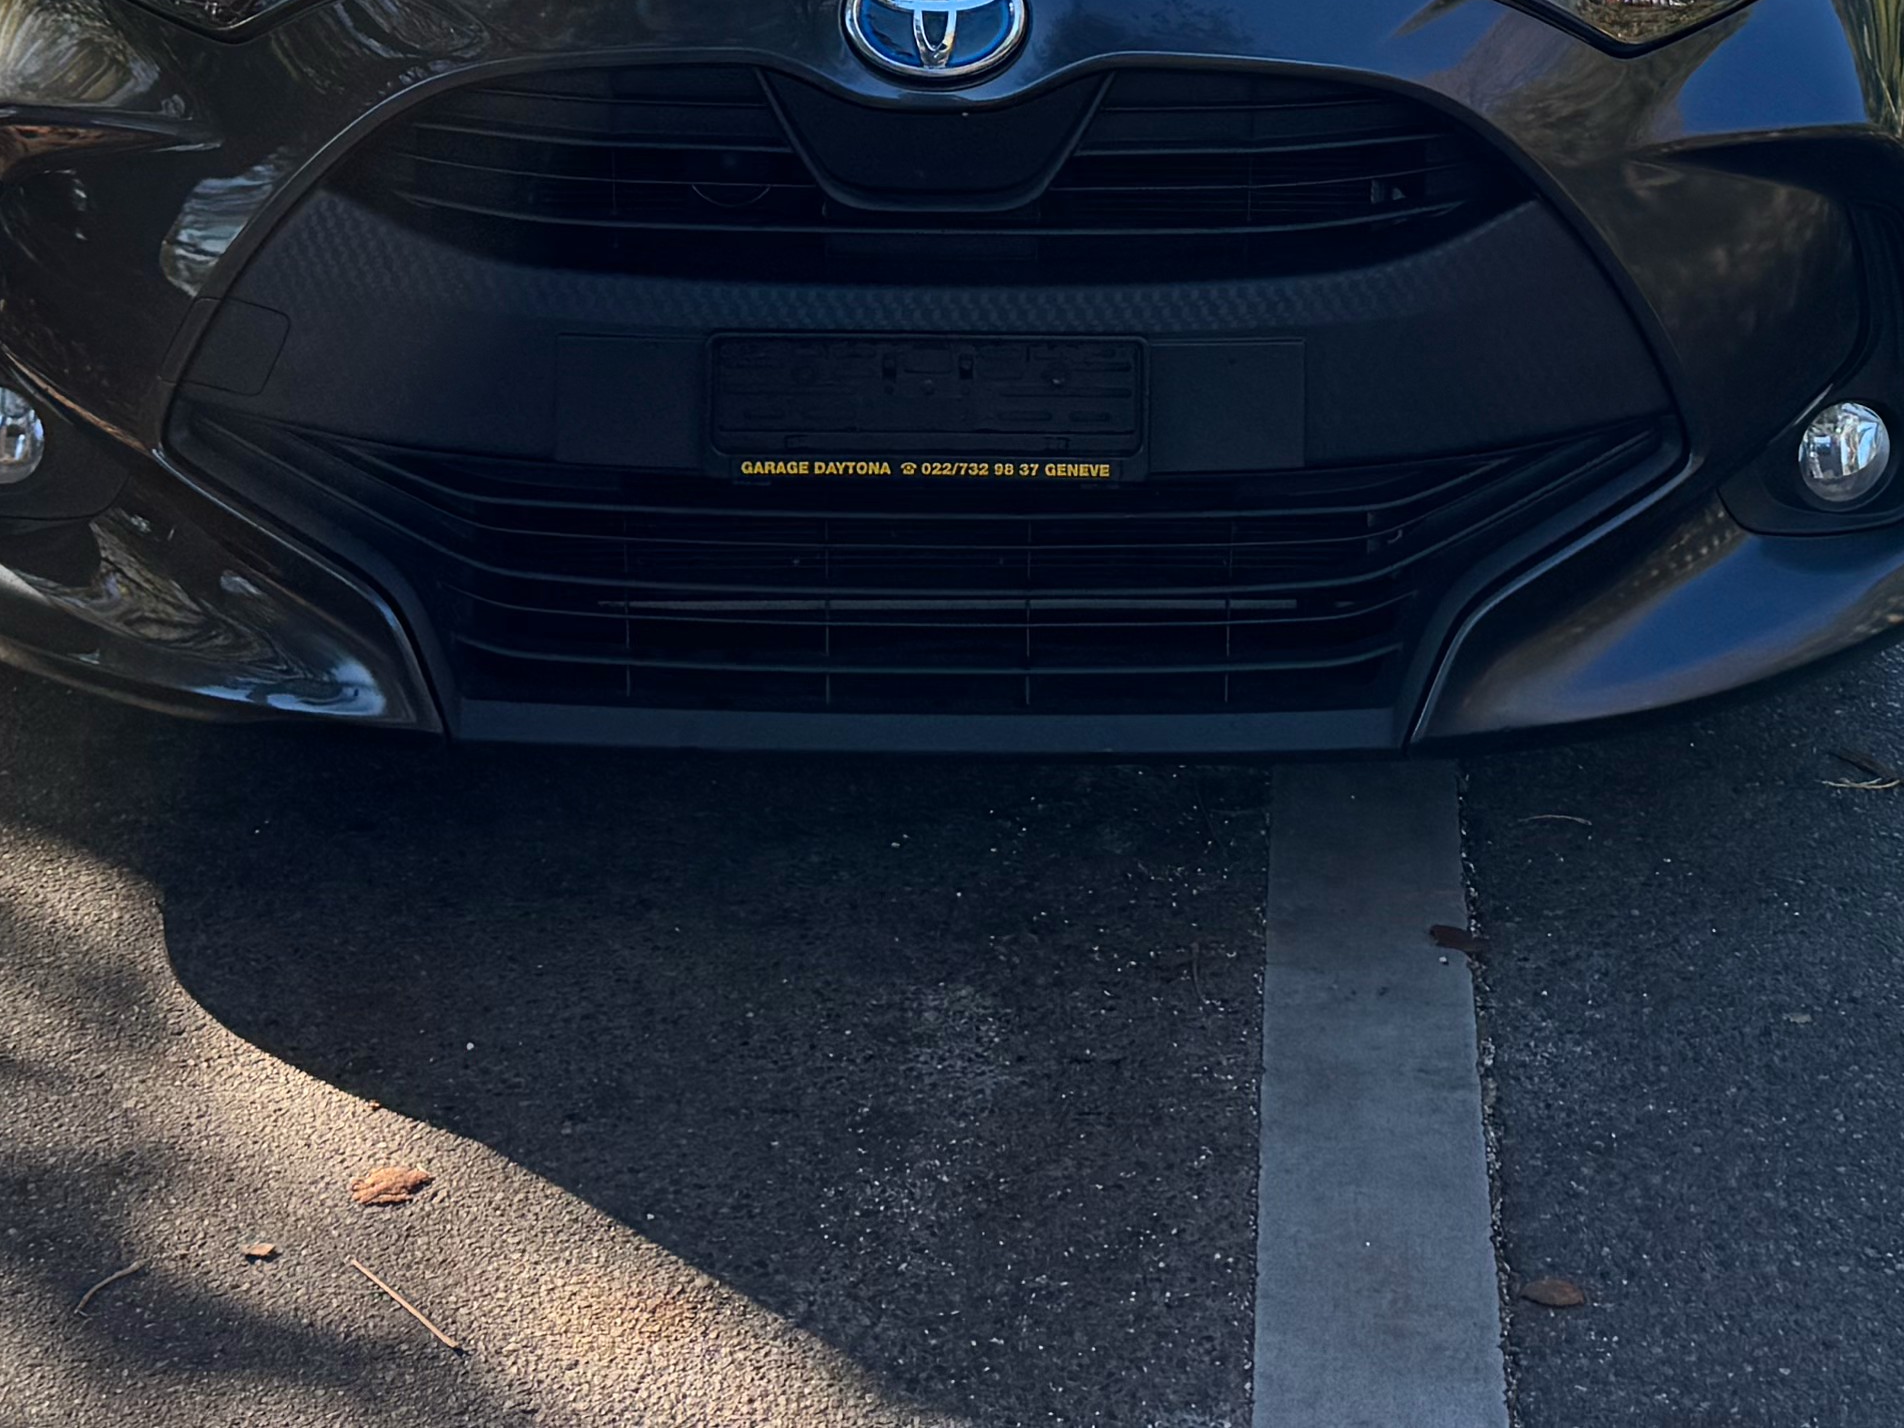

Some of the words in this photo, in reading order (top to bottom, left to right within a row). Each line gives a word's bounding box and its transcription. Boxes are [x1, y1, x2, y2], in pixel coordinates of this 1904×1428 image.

[741, 461, 809, 475] GARAGE
[814, 461, 891, 475] DAYTONA
[921, 462, 989, 476] 022/732
[994, 462, 1014, 476] 98
[1019, 463, 1039, 476] 37
[1045, 463, 1110, 477] GENEVE
